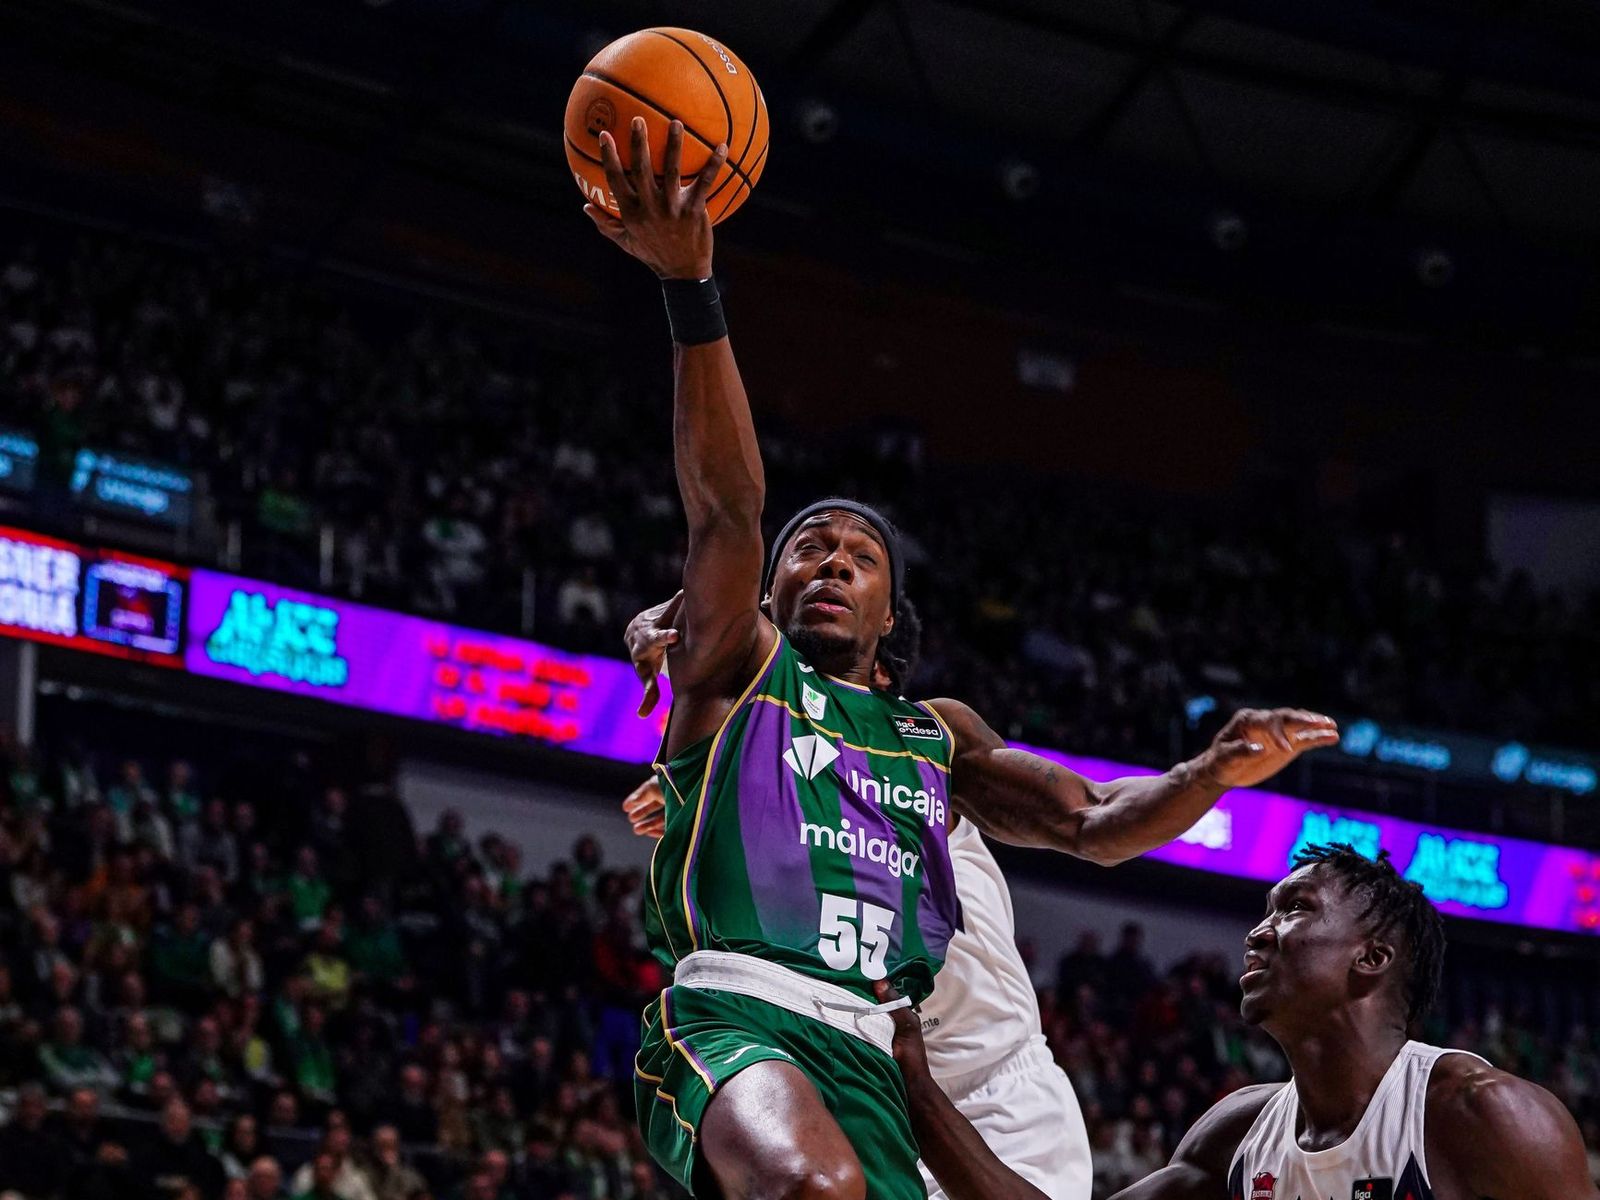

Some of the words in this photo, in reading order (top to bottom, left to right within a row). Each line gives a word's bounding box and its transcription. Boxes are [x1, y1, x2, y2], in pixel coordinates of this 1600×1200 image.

[899, 726, 939, 736] endesa
[817, 892, 896, 981] 55
[1354, 1190, 1372, 1200] liga
